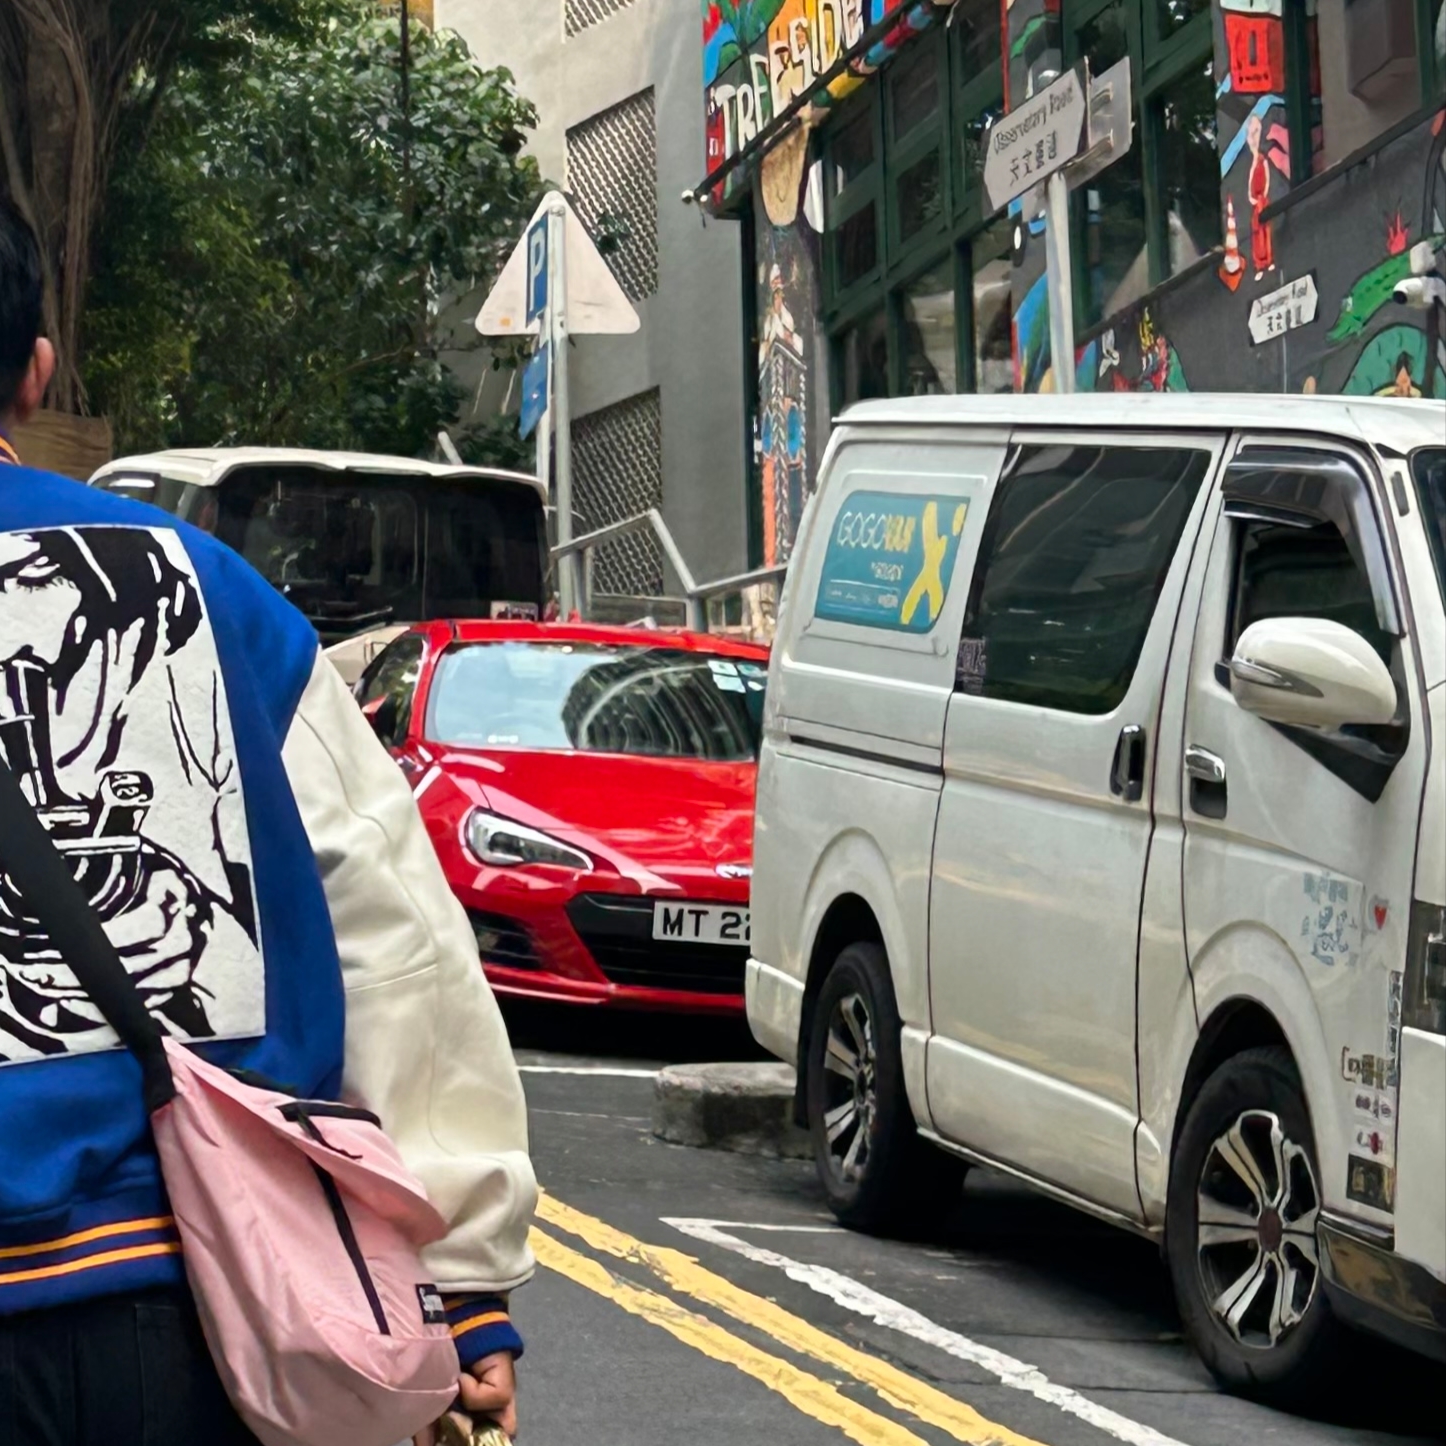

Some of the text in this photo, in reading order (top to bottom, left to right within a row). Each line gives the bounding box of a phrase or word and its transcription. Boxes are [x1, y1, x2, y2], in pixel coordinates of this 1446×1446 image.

[530, 227, 545, 311] P
[663, 907, 750, 941] MT 2
